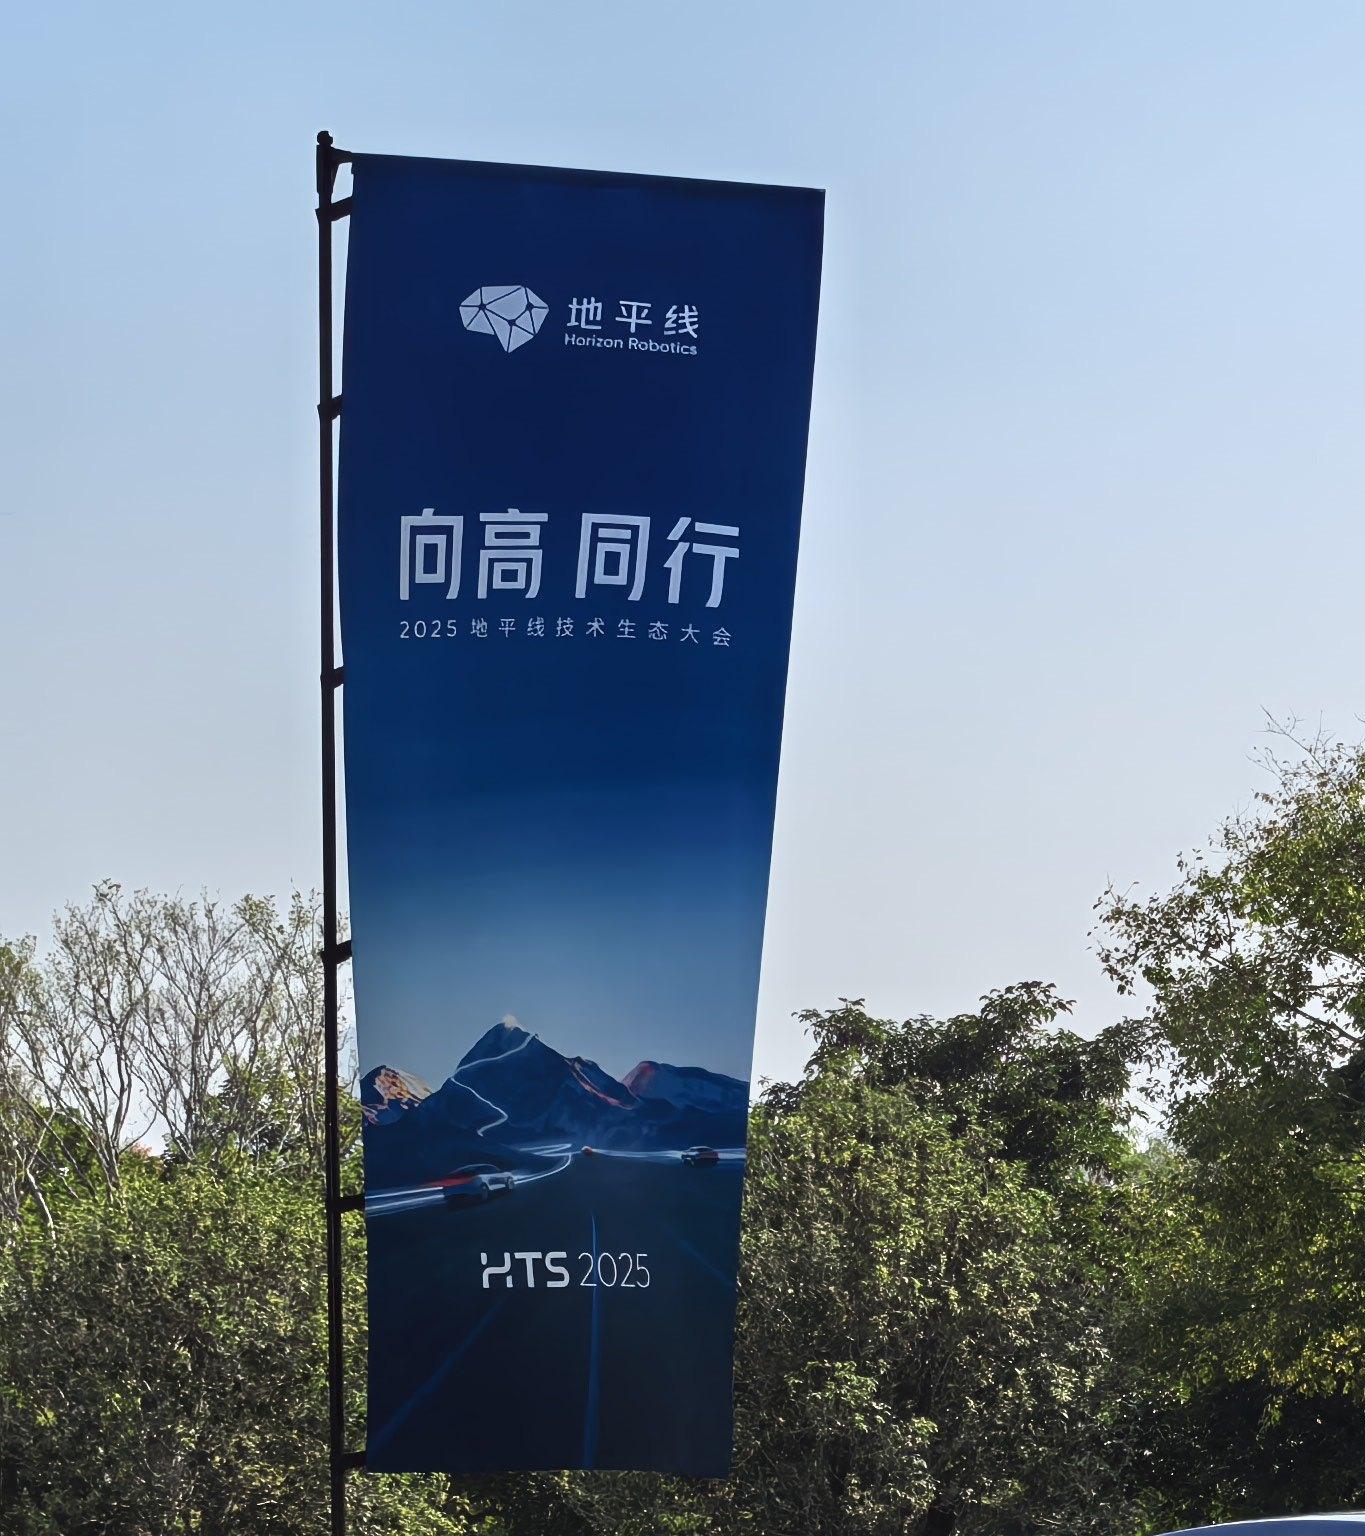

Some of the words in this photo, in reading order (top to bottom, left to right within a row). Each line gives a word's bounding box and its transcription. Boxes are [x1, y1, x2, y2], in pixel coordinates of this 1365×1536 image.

[566, 296, 699, 339] 地平线
[564, 333, 623, 349] Horizon
[628, 337, 698, 356] Robotics
[400, 508, 549, 601] 向高
[574, 512, 740, 608] 同行
[480, 1251, 570, 1289] HTS
[578, 1251, 651, 1289] 2025
